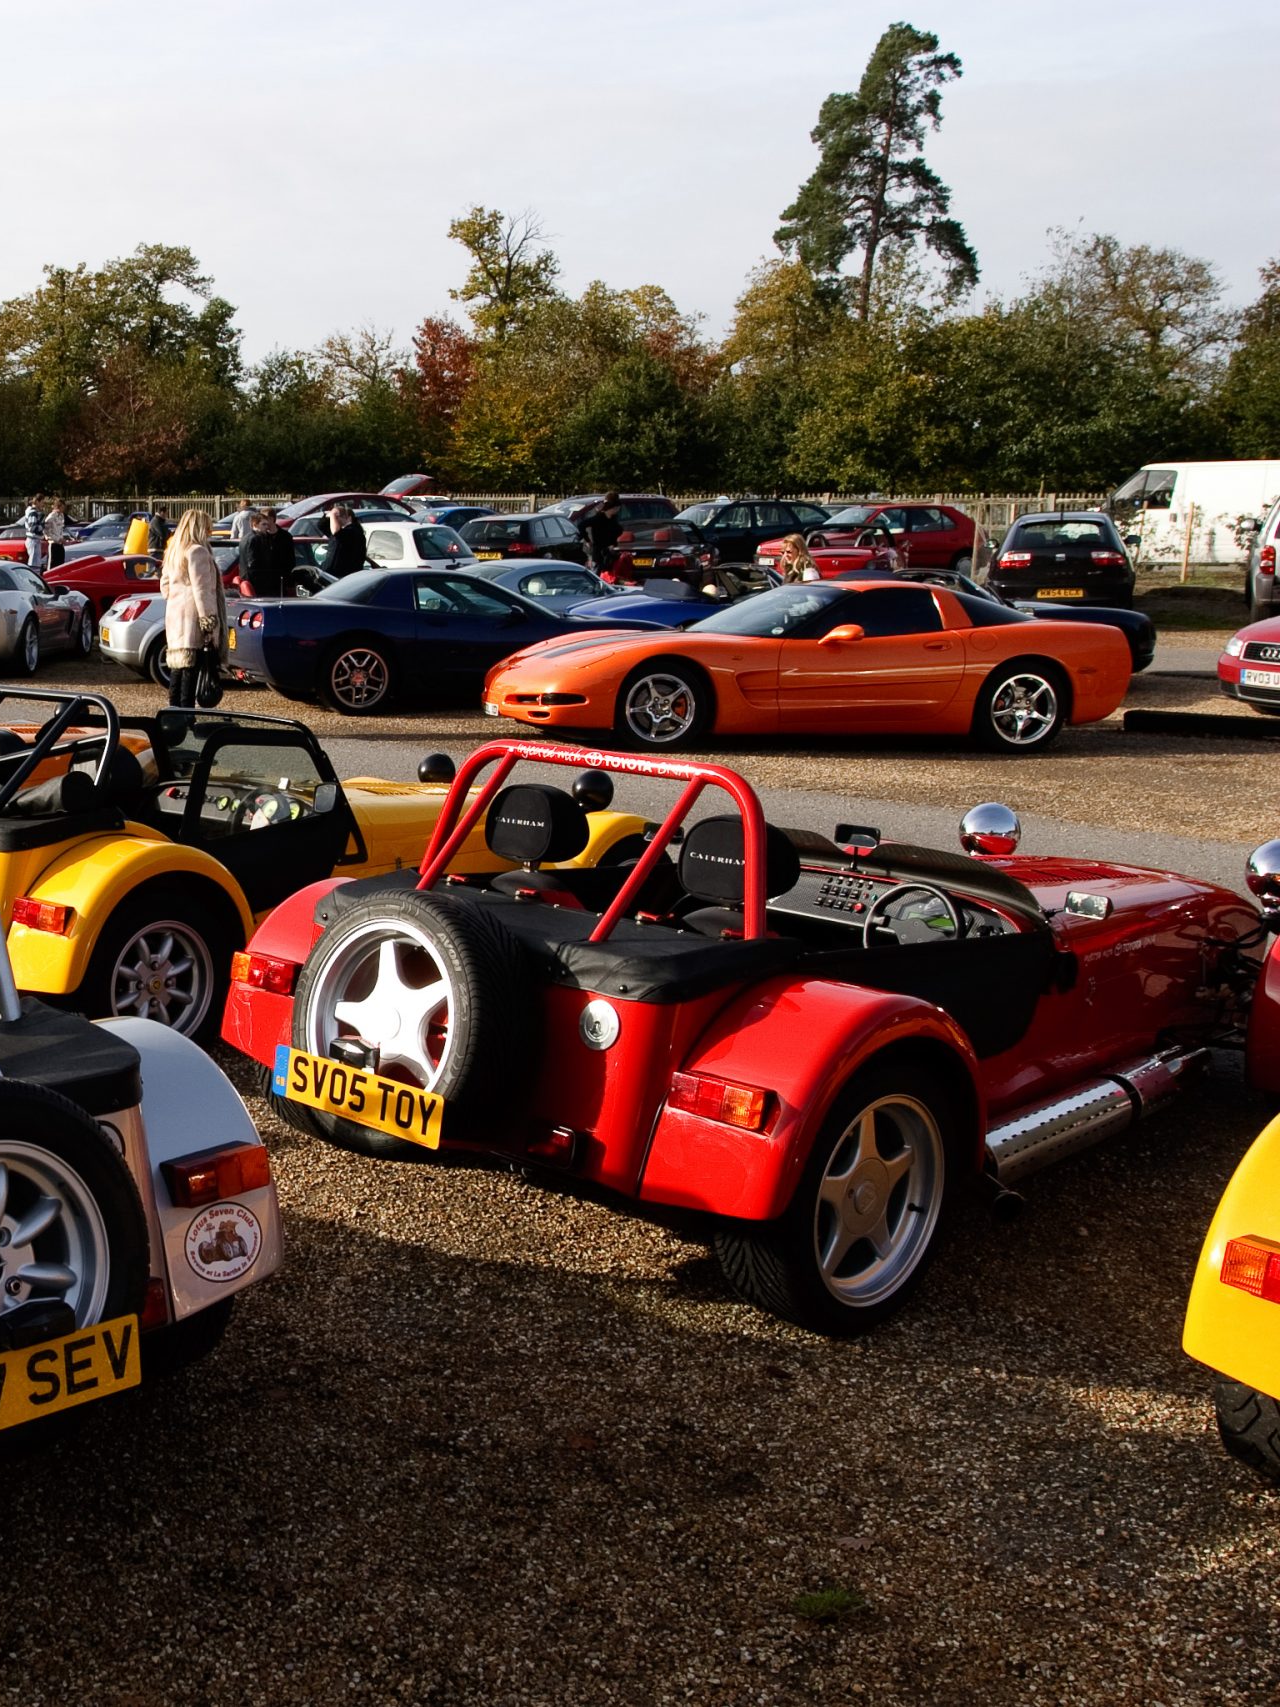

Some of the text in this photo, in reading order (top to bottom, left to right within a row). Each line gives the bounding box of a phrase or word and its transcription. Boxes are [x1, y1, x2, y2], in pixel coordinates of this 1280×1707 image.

[1246, 671, 1271, 685] RV03
[604, 754, 653, 773] TOYOTA
[657, 761, 690, 778] DNA
[436, 932, 462, 972] AVON
[292, 1055, 437, 1136] SV05 TOY
[189, 1208, 254, 1243] Lotus Seven Club
[26, 1323, 132, 1406] SEV
